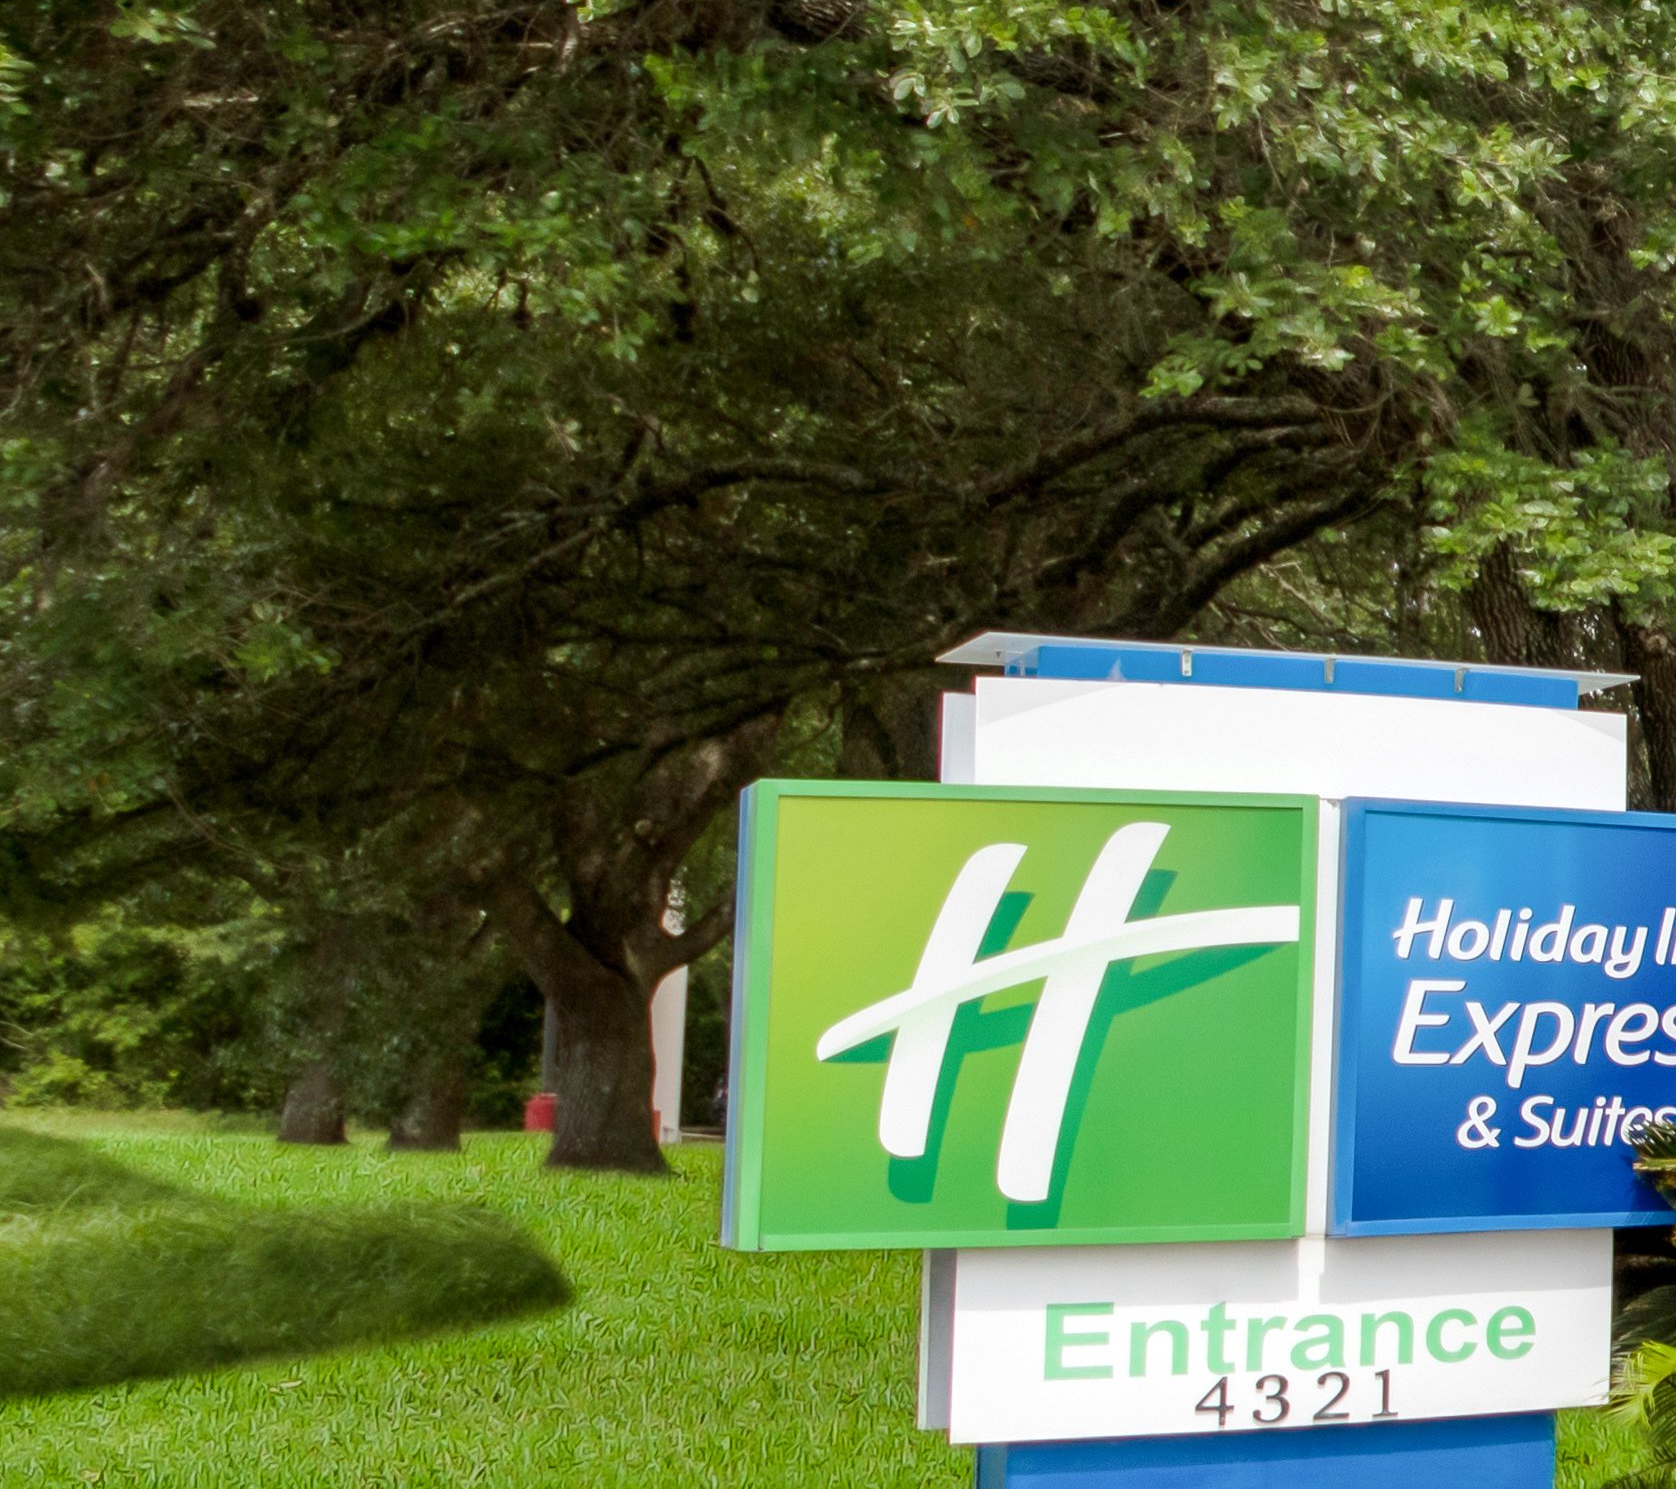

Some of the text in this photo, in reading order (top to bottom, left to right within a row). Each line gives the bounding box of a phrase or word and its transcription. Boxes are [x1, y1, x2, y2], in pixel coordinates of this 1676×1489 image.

[1392, 897, 1649, 979] Holiday
[1456, 1095, 1501, 1149] &
[1043, 1301, 1537, 1382] Entrance
[1194, 1368, 1400, 1429] 4321
